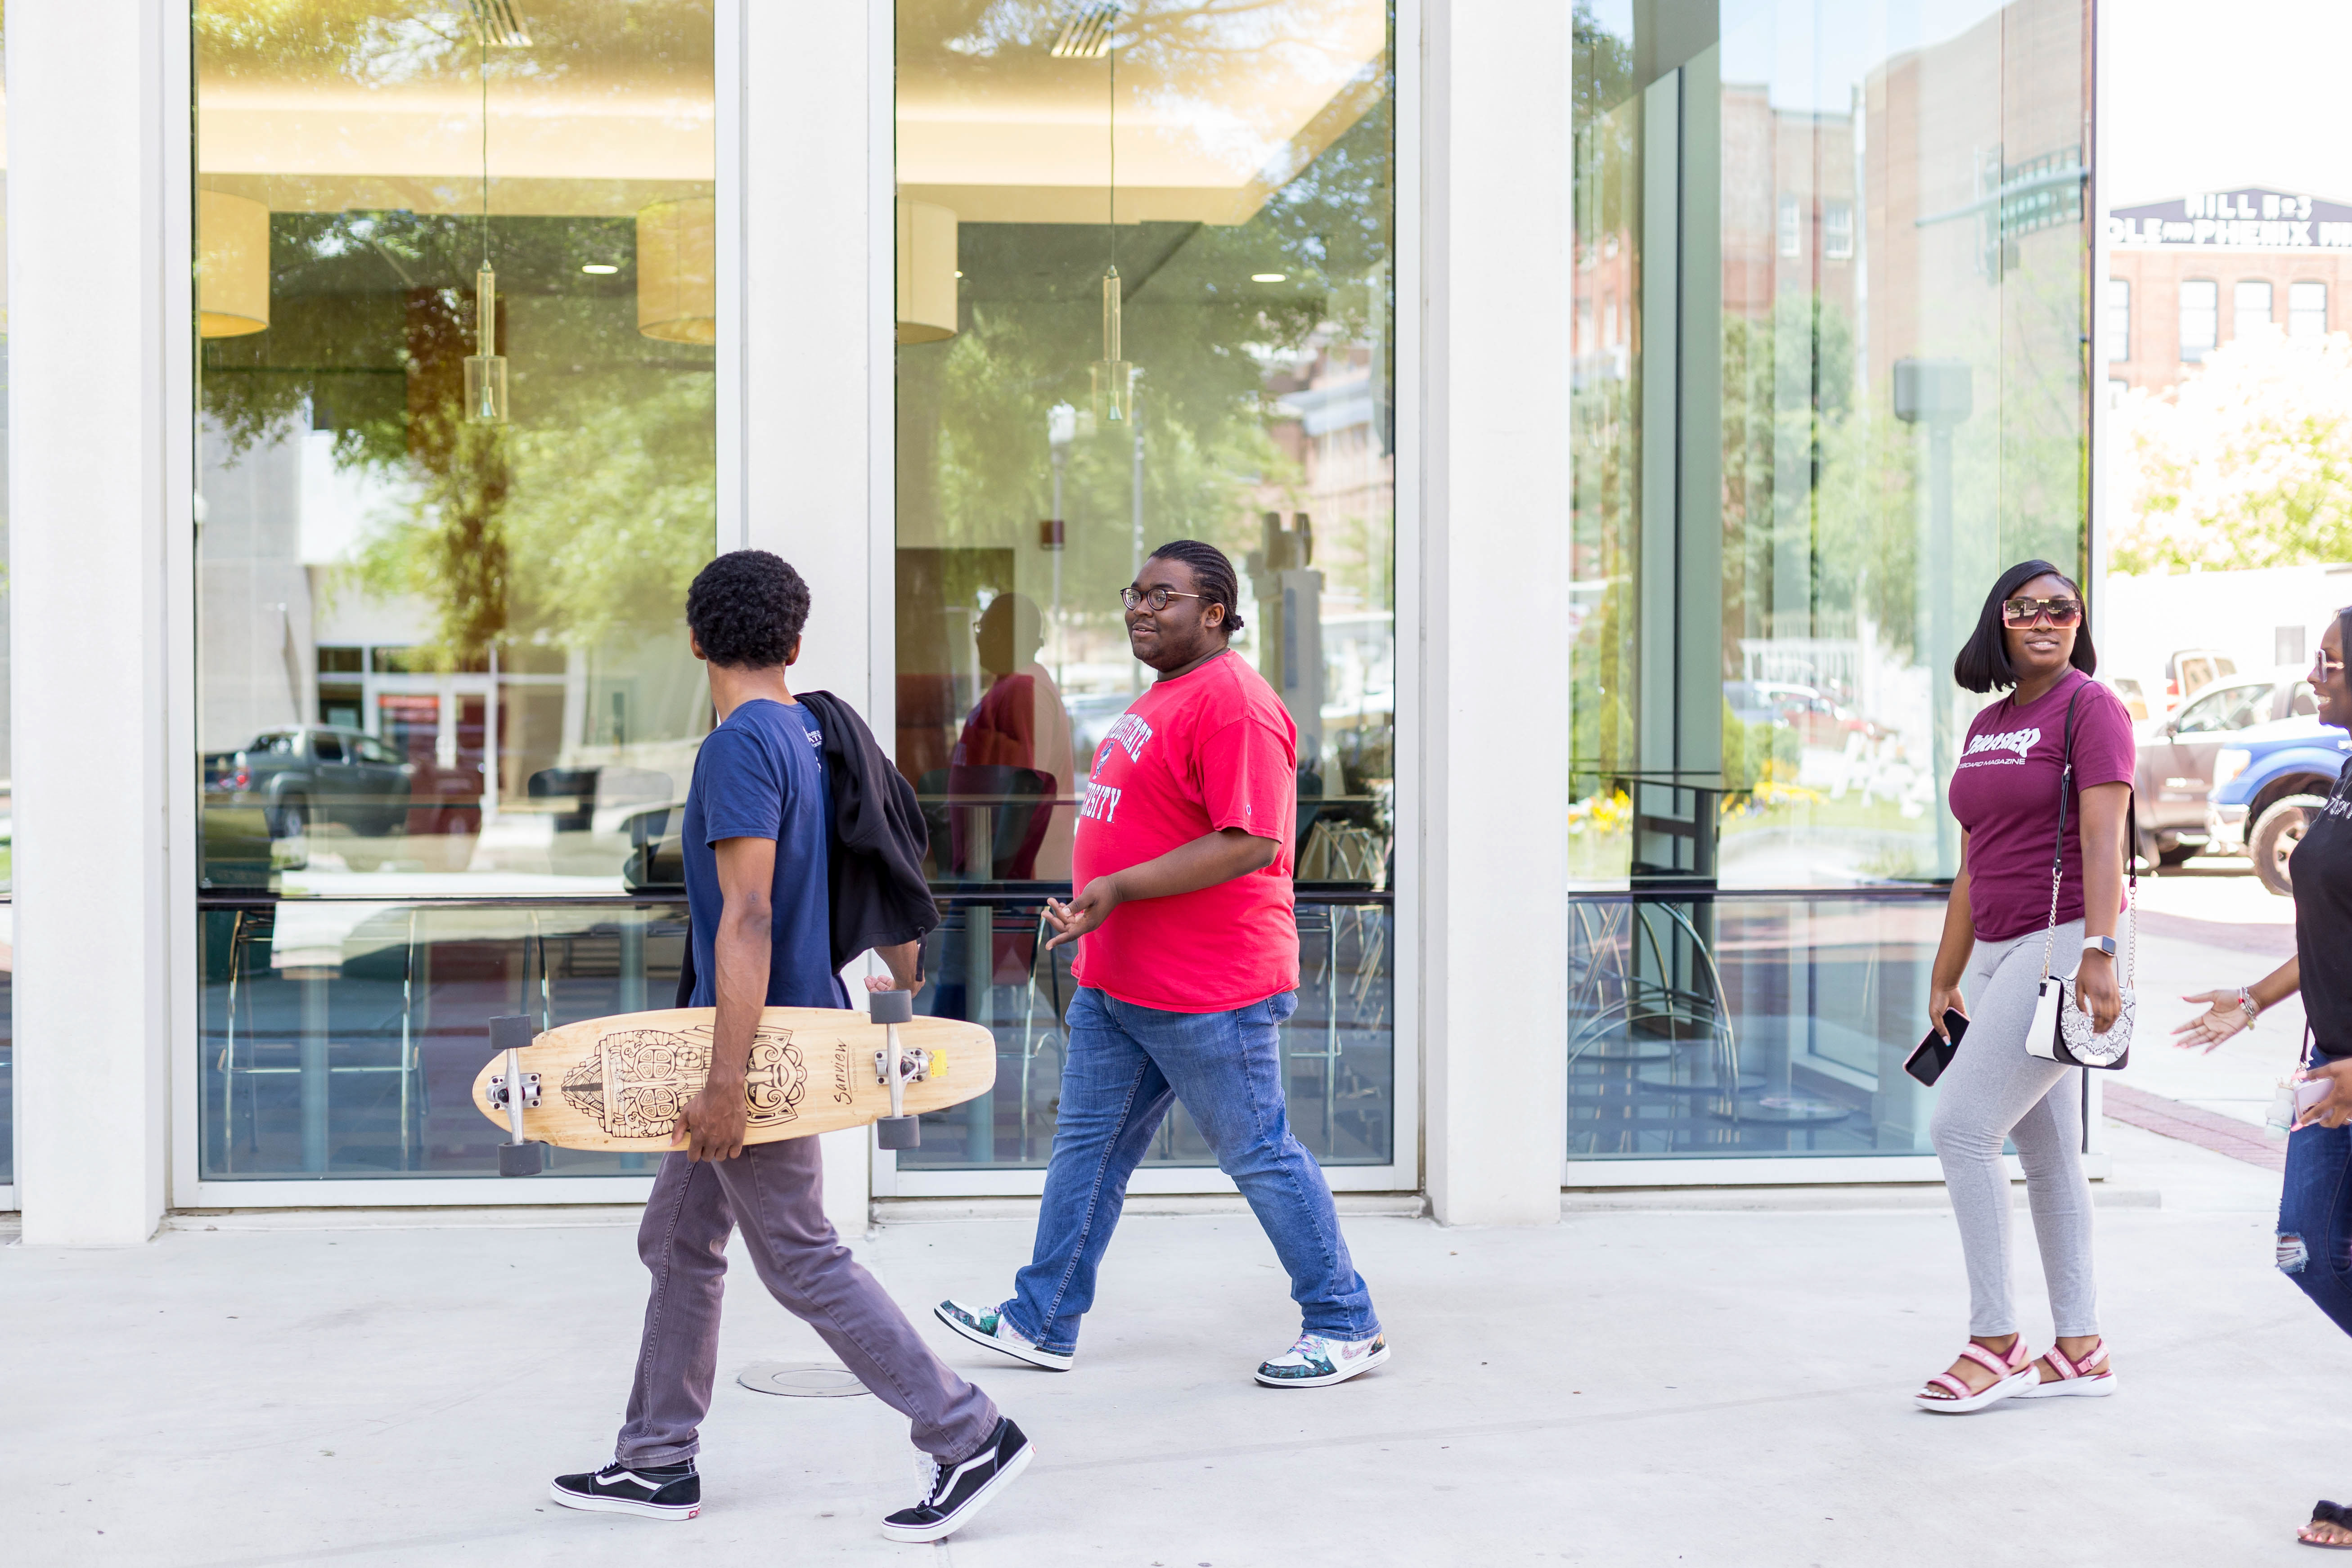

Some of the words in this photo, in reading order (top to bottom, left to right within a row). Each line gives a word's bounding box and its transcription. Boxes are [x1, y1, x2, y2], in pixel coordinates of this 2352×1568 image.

[2185, 193, 2258, 220] MILL
[2193, 219, 2313, 246] PHENIX
[2319, 221, 2352, 247] MI
[1120, 715, 1153, 764] STATE
[1983, 758, 2025, 766] MAGAZINE
[831, 1038, 852, 1105] Sanview
